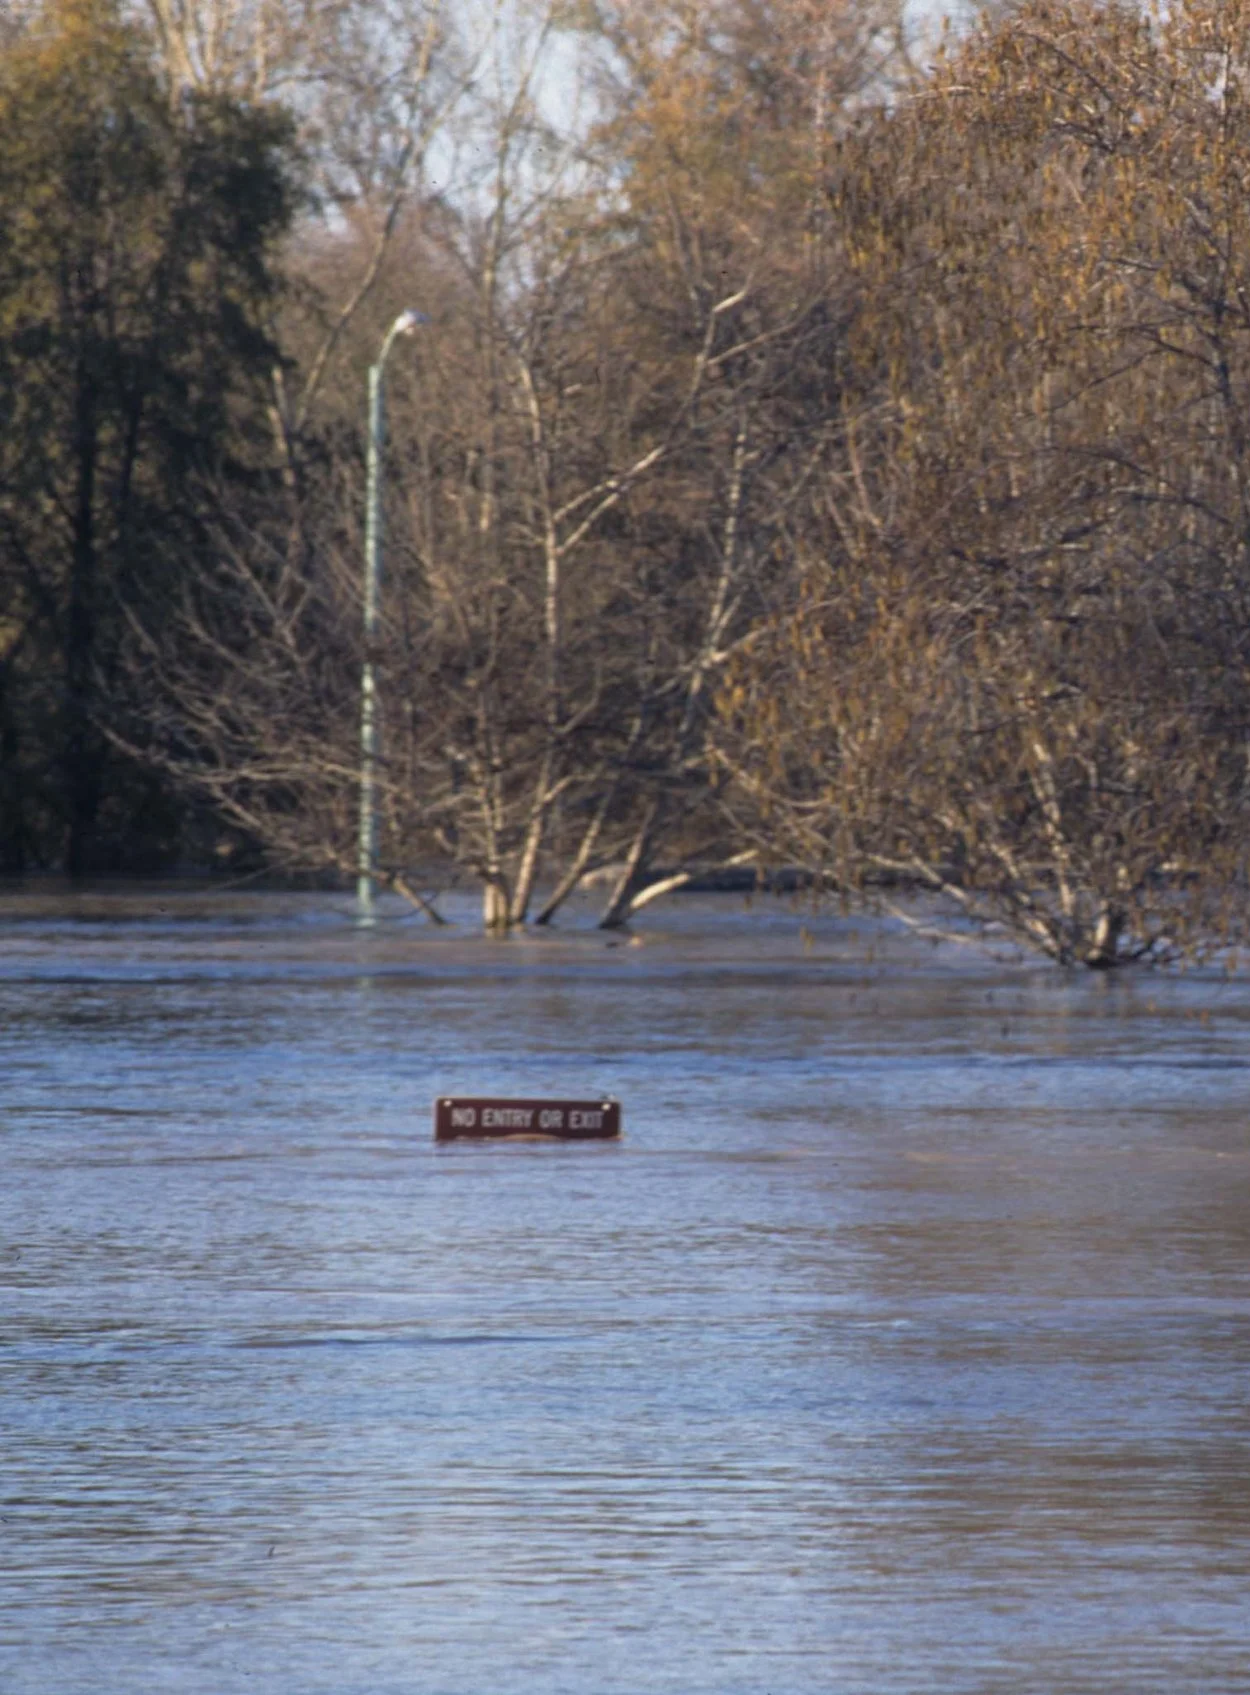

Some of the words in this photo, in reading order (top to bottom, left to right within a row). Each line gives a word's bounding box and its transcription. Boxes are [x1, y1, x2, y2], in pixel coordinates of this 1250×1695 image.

[451, 1108, 476, 1127] NO
[481, 1108, 533, 1128] ENTRY
[539, 1109, 563, 1129] OR
[568, 1110, 605, 1129] EXIT
